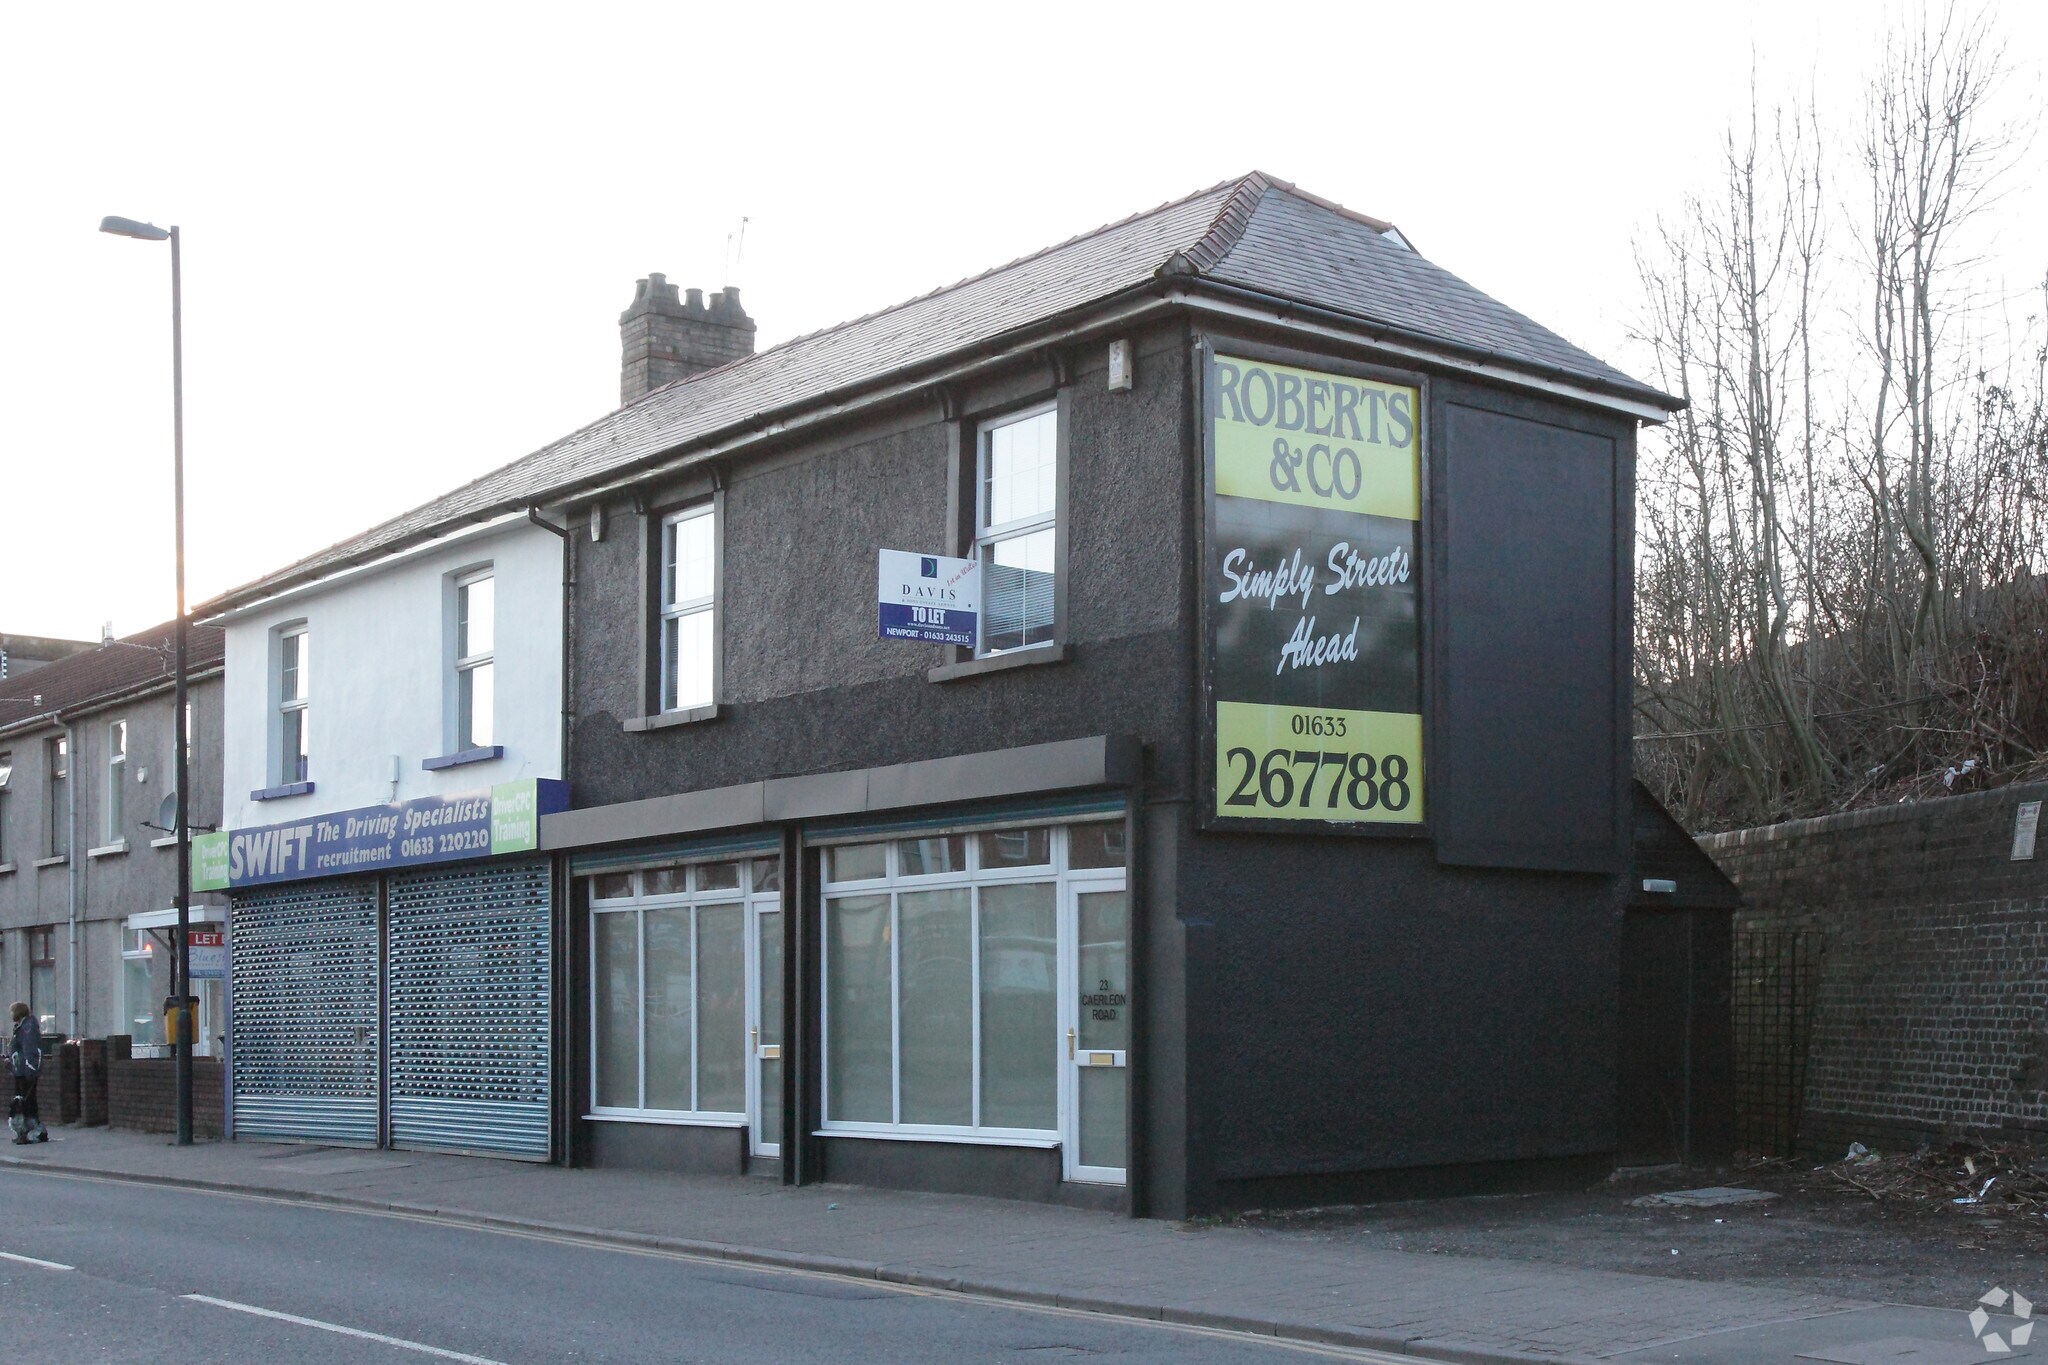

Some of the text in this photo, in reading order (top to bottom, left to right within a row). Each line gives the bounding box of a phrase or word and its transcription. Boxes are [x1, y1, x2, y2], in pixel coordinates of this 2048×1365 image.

[1214, 361, 1413, 448] ROBERTS
[1220, 542, 1410, 610] Simply Streets
[902, 584, 956, 600] DAVIS
[912, 606, 946, 625] TO LET
[886, 627, 919, 638] NEWPORT
[924, 631, 944, 640] 01633
[945, 634, 969, 643] 243515
[1276, 616, 1360, 675] Ahead
[1291, 714, 1347, 737] 01633
[1224, 747, 1411, 811] 267788
[317, 799, 488, 843] The Driving Specialists
[493, 818, 531, 843] Training
[230, 825, 313, 880] SWIFT
[318, 829, 488, 868] recruitment 01633 220220
[202, 861, 228, 883] Training
[195, 934, 218, 944] LET
[1099, 980, 1109, 990] 23
[1082, 994, 1126, 1006] CAERLEON
[1092, 1009, 1116, 1020] ROAD
